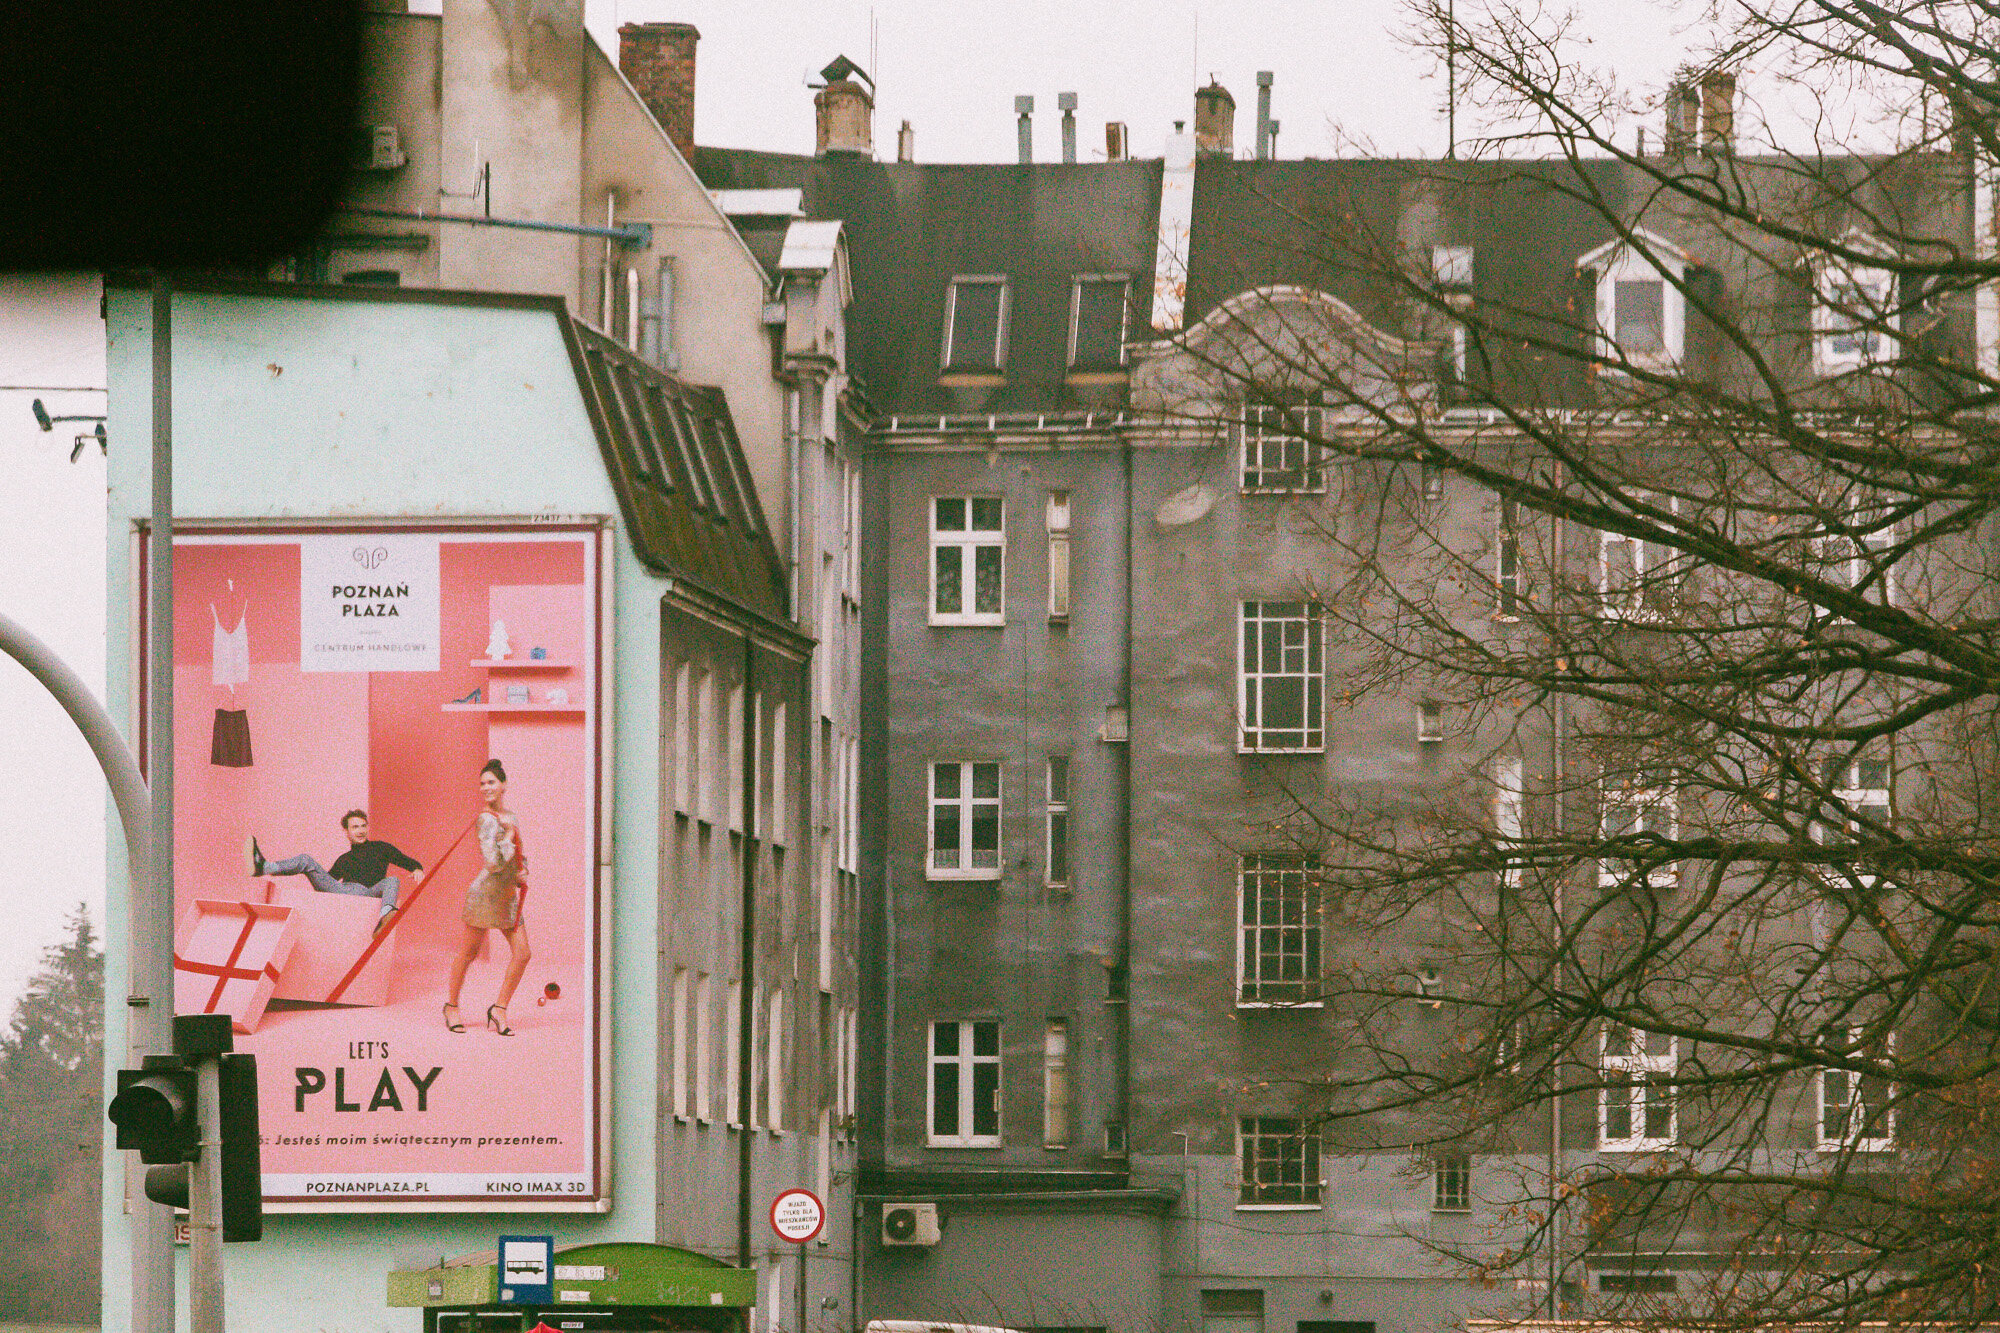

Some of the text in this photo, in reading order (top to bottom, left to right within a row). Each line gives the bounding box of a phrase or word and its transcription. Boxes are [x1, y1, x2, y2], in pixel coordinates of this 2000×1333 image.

[332, 581, 409, 598] POZNAŃ
[342, 604, 399, 616] PLAZA
[314, 644, 364, 652] CENTRUM
[349, 1042, 389, 1059] LET'S
[295, 1066, 443, 1112] PLAY
[275, 1134, 320, 1145] Jesteś
[326, 1134, 367, 1145] moim
[372, 1134, 472, 1147] świątecznym
[478, 1135, 563, 1148] prezentem.
[306, 1182, 586, 1193] POZNANPLAZA.PL KINO IMAX 3D
